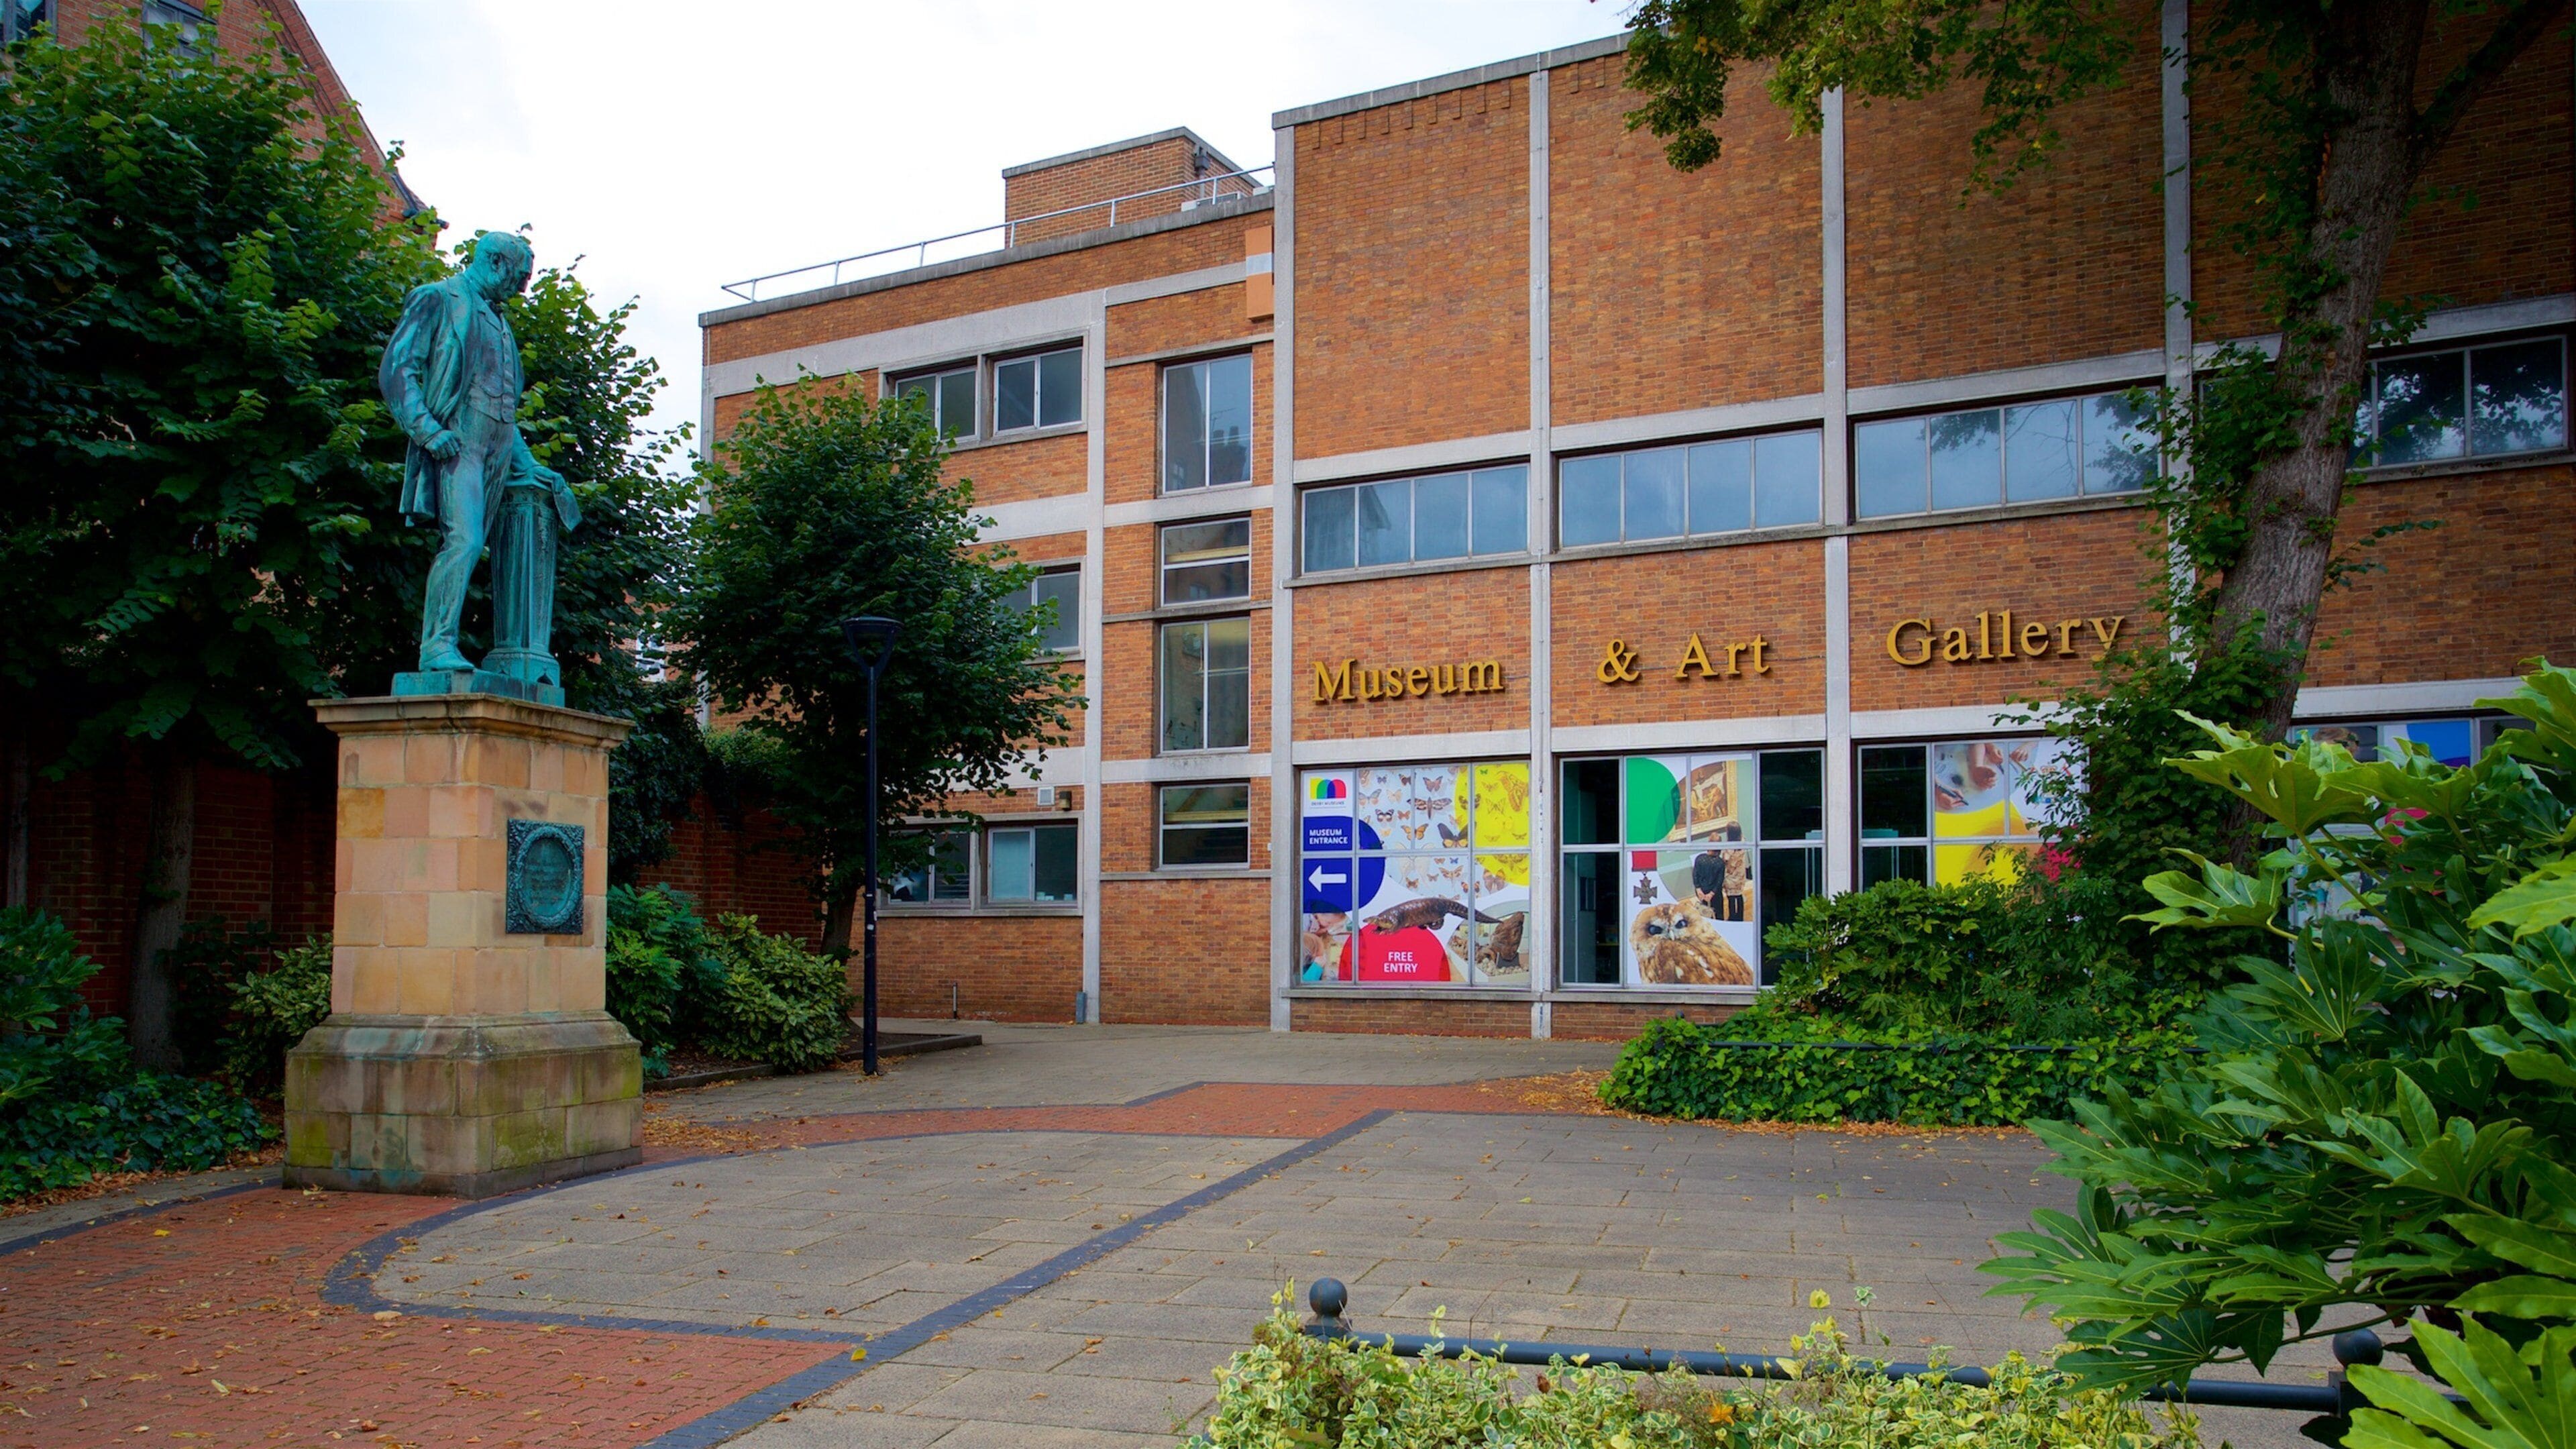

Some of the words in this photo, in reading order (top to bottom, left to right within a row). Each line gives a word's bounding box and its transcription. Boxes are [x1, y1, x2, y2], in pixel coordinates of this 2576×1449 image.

[1311, 658, 1505, 701] Museum
[1596, 639, 1640, 683] &
[1673, 632, 1770, 678] Art
[1886, 608, 2125, 663] Gallery
[1309, 837, 1348, 845] ENTRANCE
[1388, 951, 1413, 961] FREE
[1384, 963, 1418, 973] ENTRY
